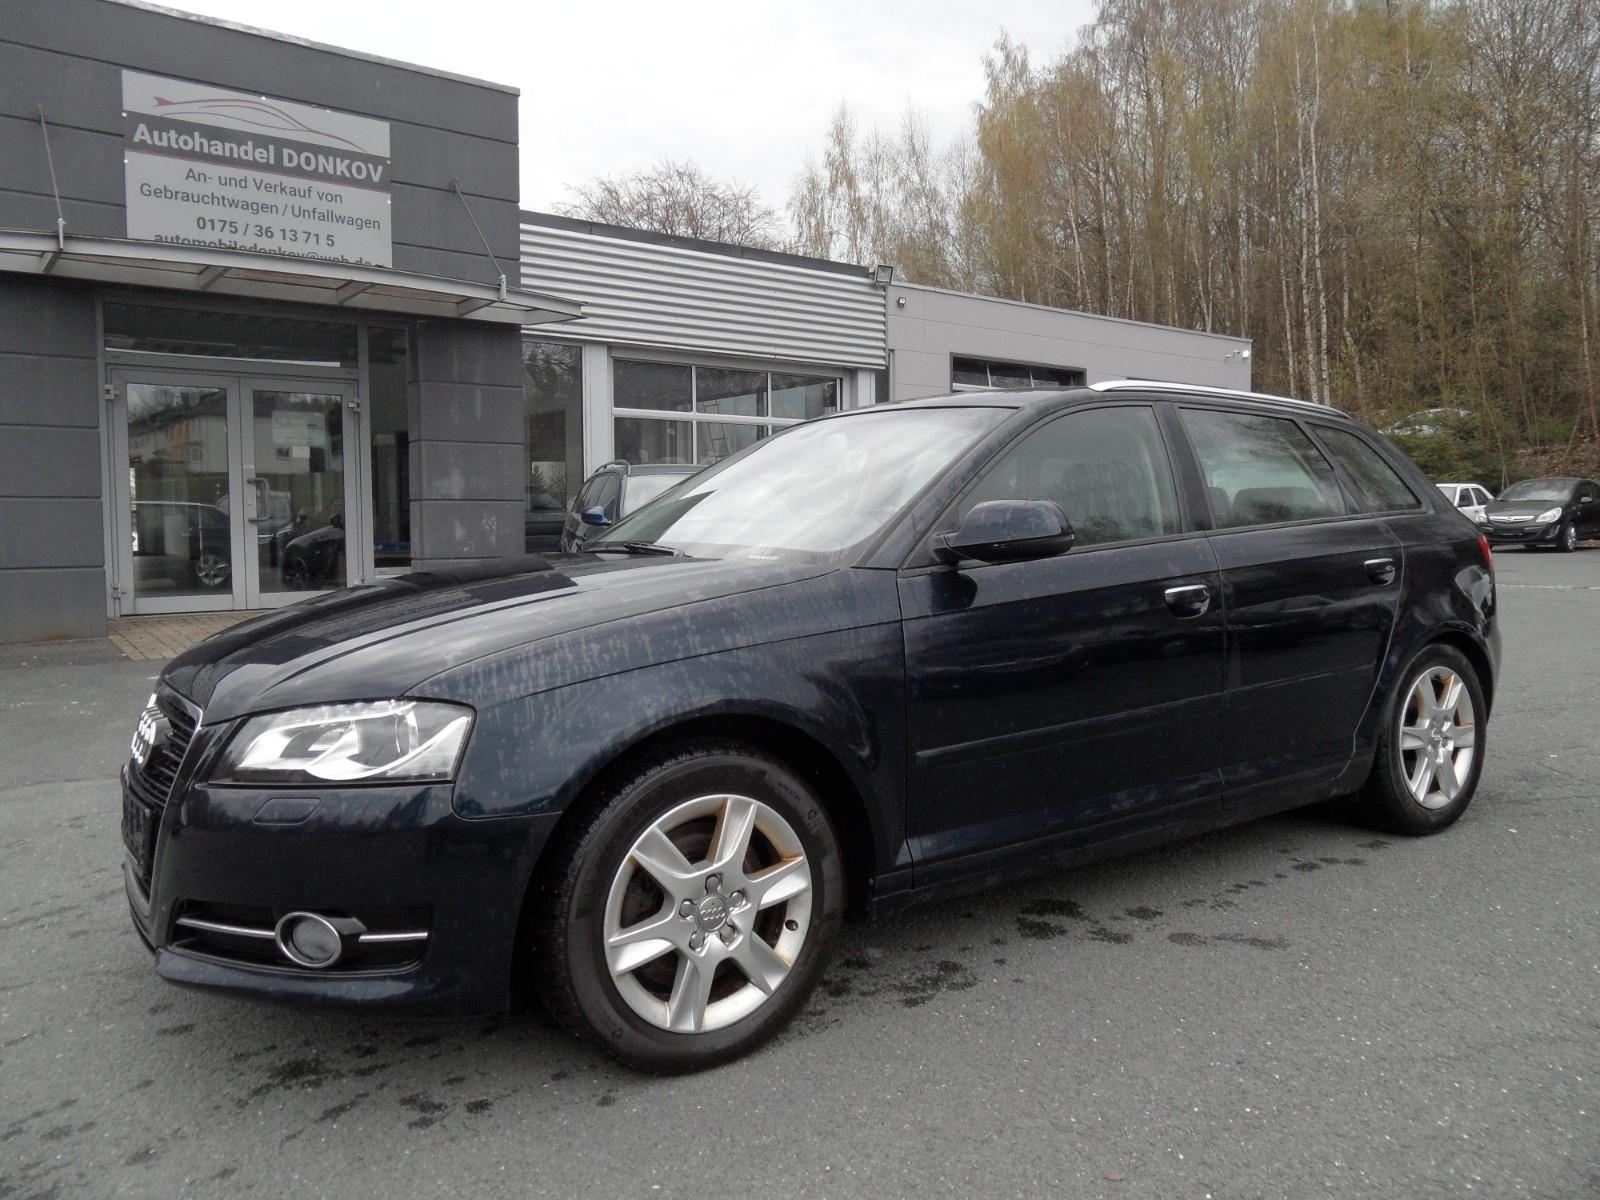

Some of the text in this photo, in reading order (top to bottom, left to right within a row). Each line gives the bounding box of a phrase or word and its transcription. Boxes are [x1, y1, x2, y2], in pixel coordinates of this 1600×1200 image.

[133, 123, 383, 183] Autohandel DONKOV
[139, 182, 279, 215] Gebrauchtwagen
[290, 205, 381, 231] Unfallwagen
[185, 168, 343, 204] An- und Verkauf von
[196, 216, 239, 234] 0175
[253, 224, 274, 239] 36
[279, 228, 298, 242] 13
